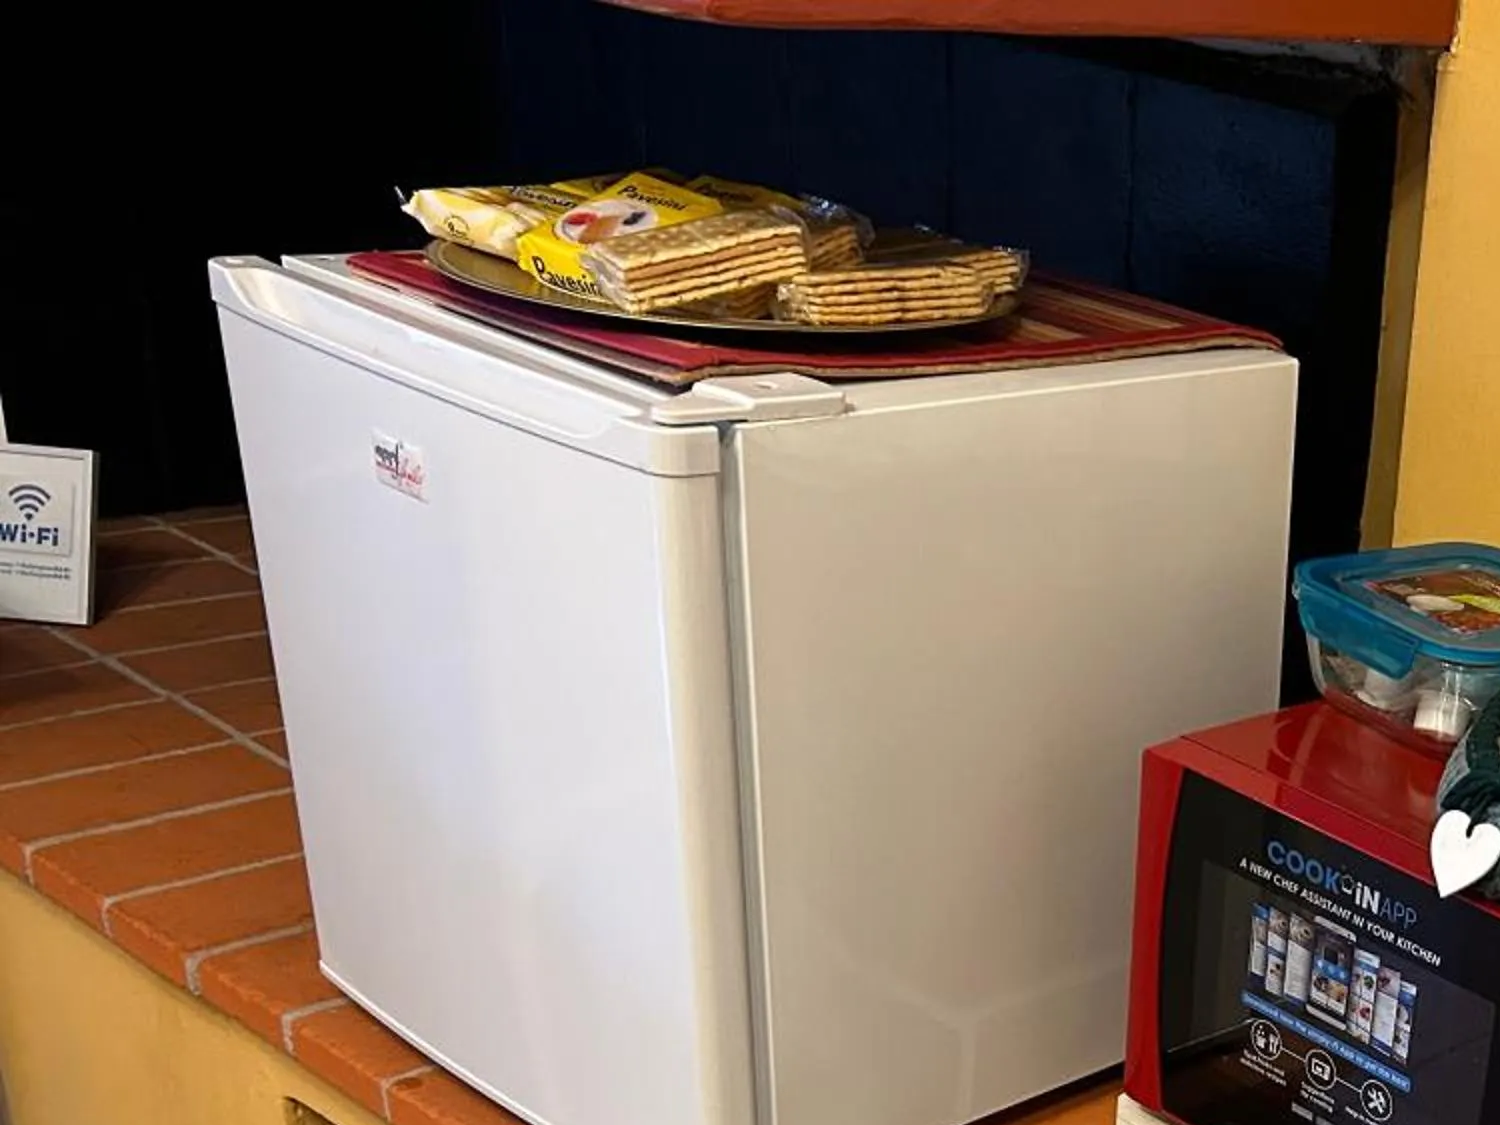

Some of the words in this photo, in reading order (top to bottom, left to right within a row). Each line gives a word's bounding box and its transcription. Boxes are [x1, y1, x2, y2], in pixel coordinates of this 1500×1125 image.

[617, 184, 687, 212] Pavesini
[1239, 857, 1247, 869] A
[1249, 862, 1272, 882] NEW
[1273, 874, 1300, 893] CHEF
[1300, 888, 1352, 921] ASSISTANT
[1352, 914, 1366, 927] IN
[1366, 921, 1396, 943] YOUR
[1396, 936, 1442, 967] KITCHEN
